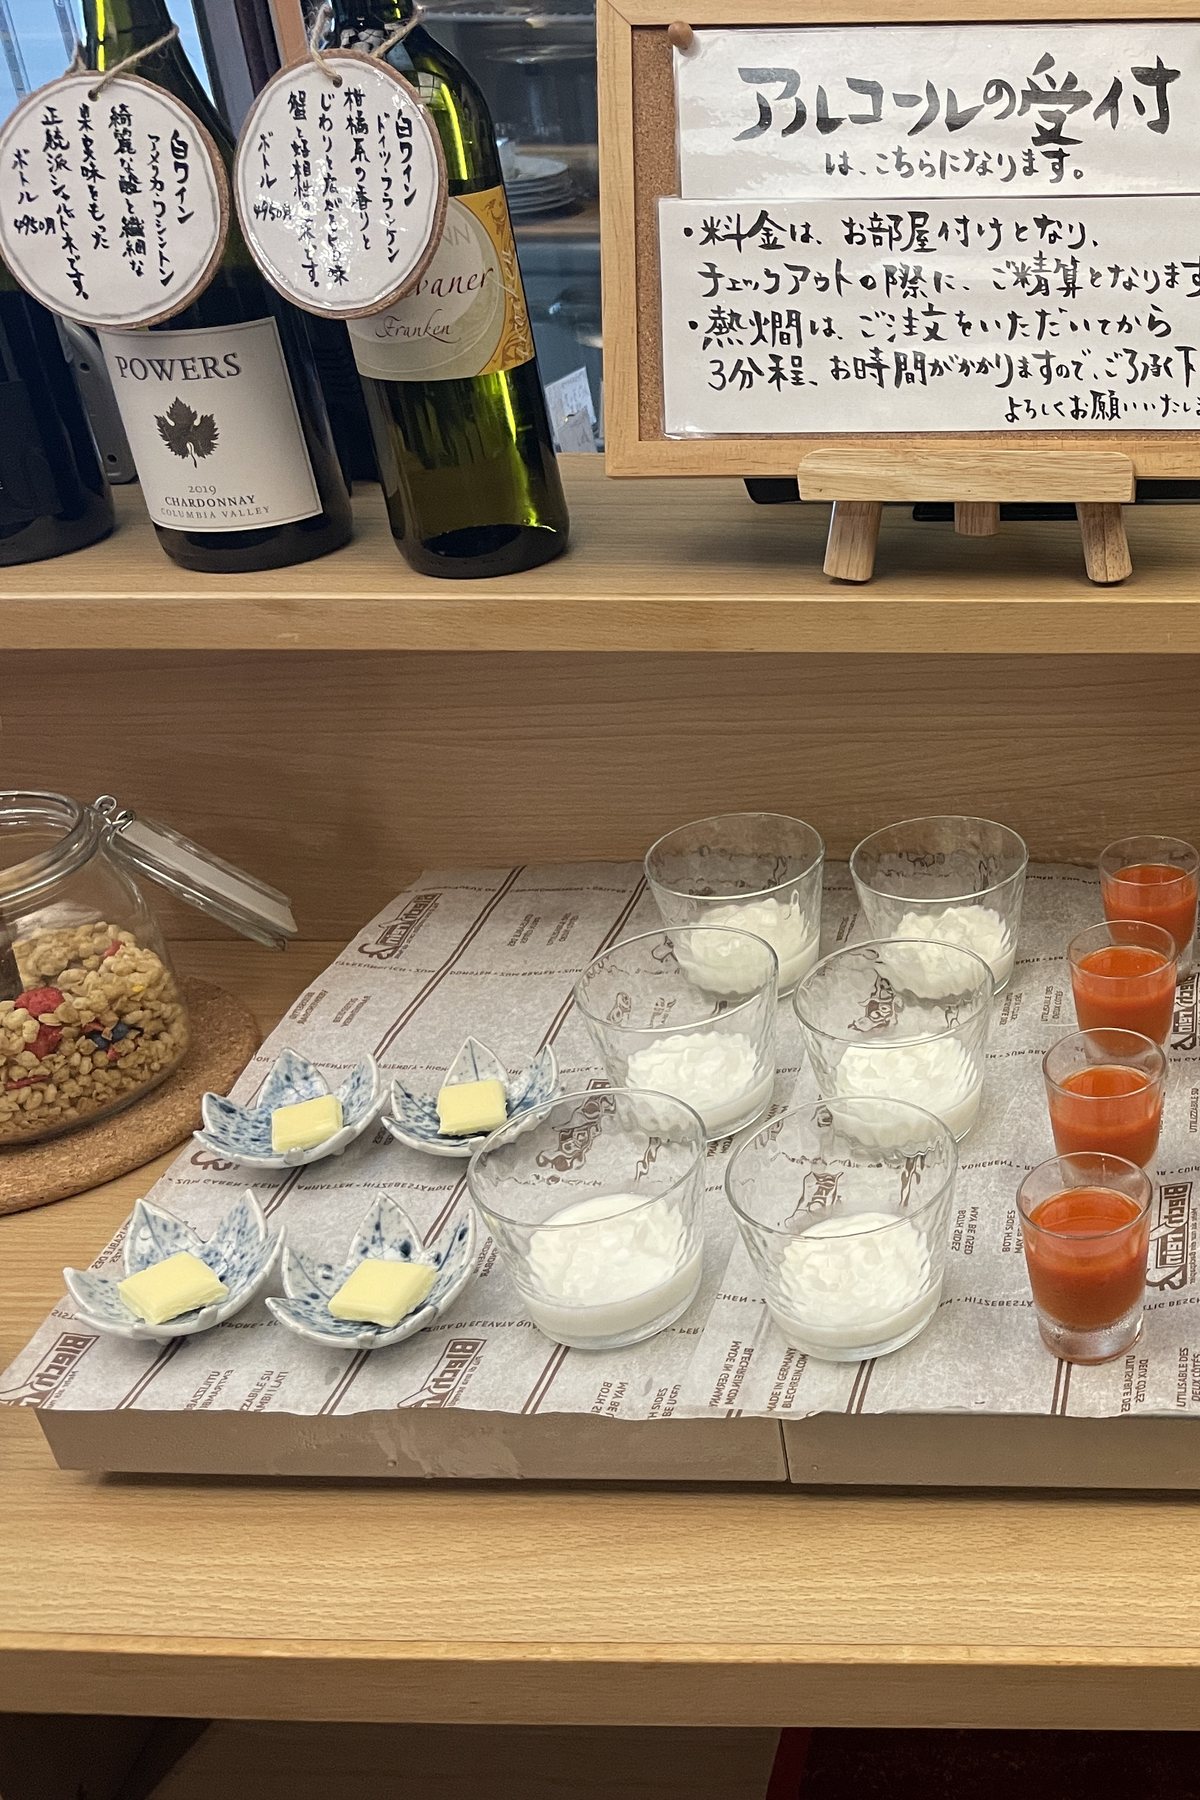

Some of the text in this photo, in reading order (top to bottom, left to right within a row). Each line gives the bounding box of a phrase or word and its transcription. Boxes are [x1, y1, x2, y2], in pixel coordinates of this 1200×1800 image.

[734, 52, 1181, 145] アルコールの受付
[258, 131, 277, 188] ボトル
[396, 109, 416, 207] 白ワイン
[825, 148, 1084, 183] は、こちらになります。
[171, 129, 194, 224] 白ワイン
[414, 268, 494, 298] vaner
[375, 309, 461, 343] Franken
[115, 353, 241, 381] POWERS
[165, 495, 255, 507] CHARDONNAY
[188, 486, 217, 495] 2019
[161, 506, 270, 519] COLUMBIA VALLEY
[1001, 1210, 1015, 1252] BOTH SIDES
[261, 1370, 274, 1381] SU
[272, 1371, 289, 1388] LATI
[776, 1347, 796, 1381] GERMANY
[1176, 1347, 1188, 1408] UTILISABLE DES
[773, 1382, 785, 1390] IN
[781, 1353, 809, 1409] BLECHREIN.COM
[1191, 1379, 1200, 1402] DEUX
[650, 1387, 668, 1410] SIDES
